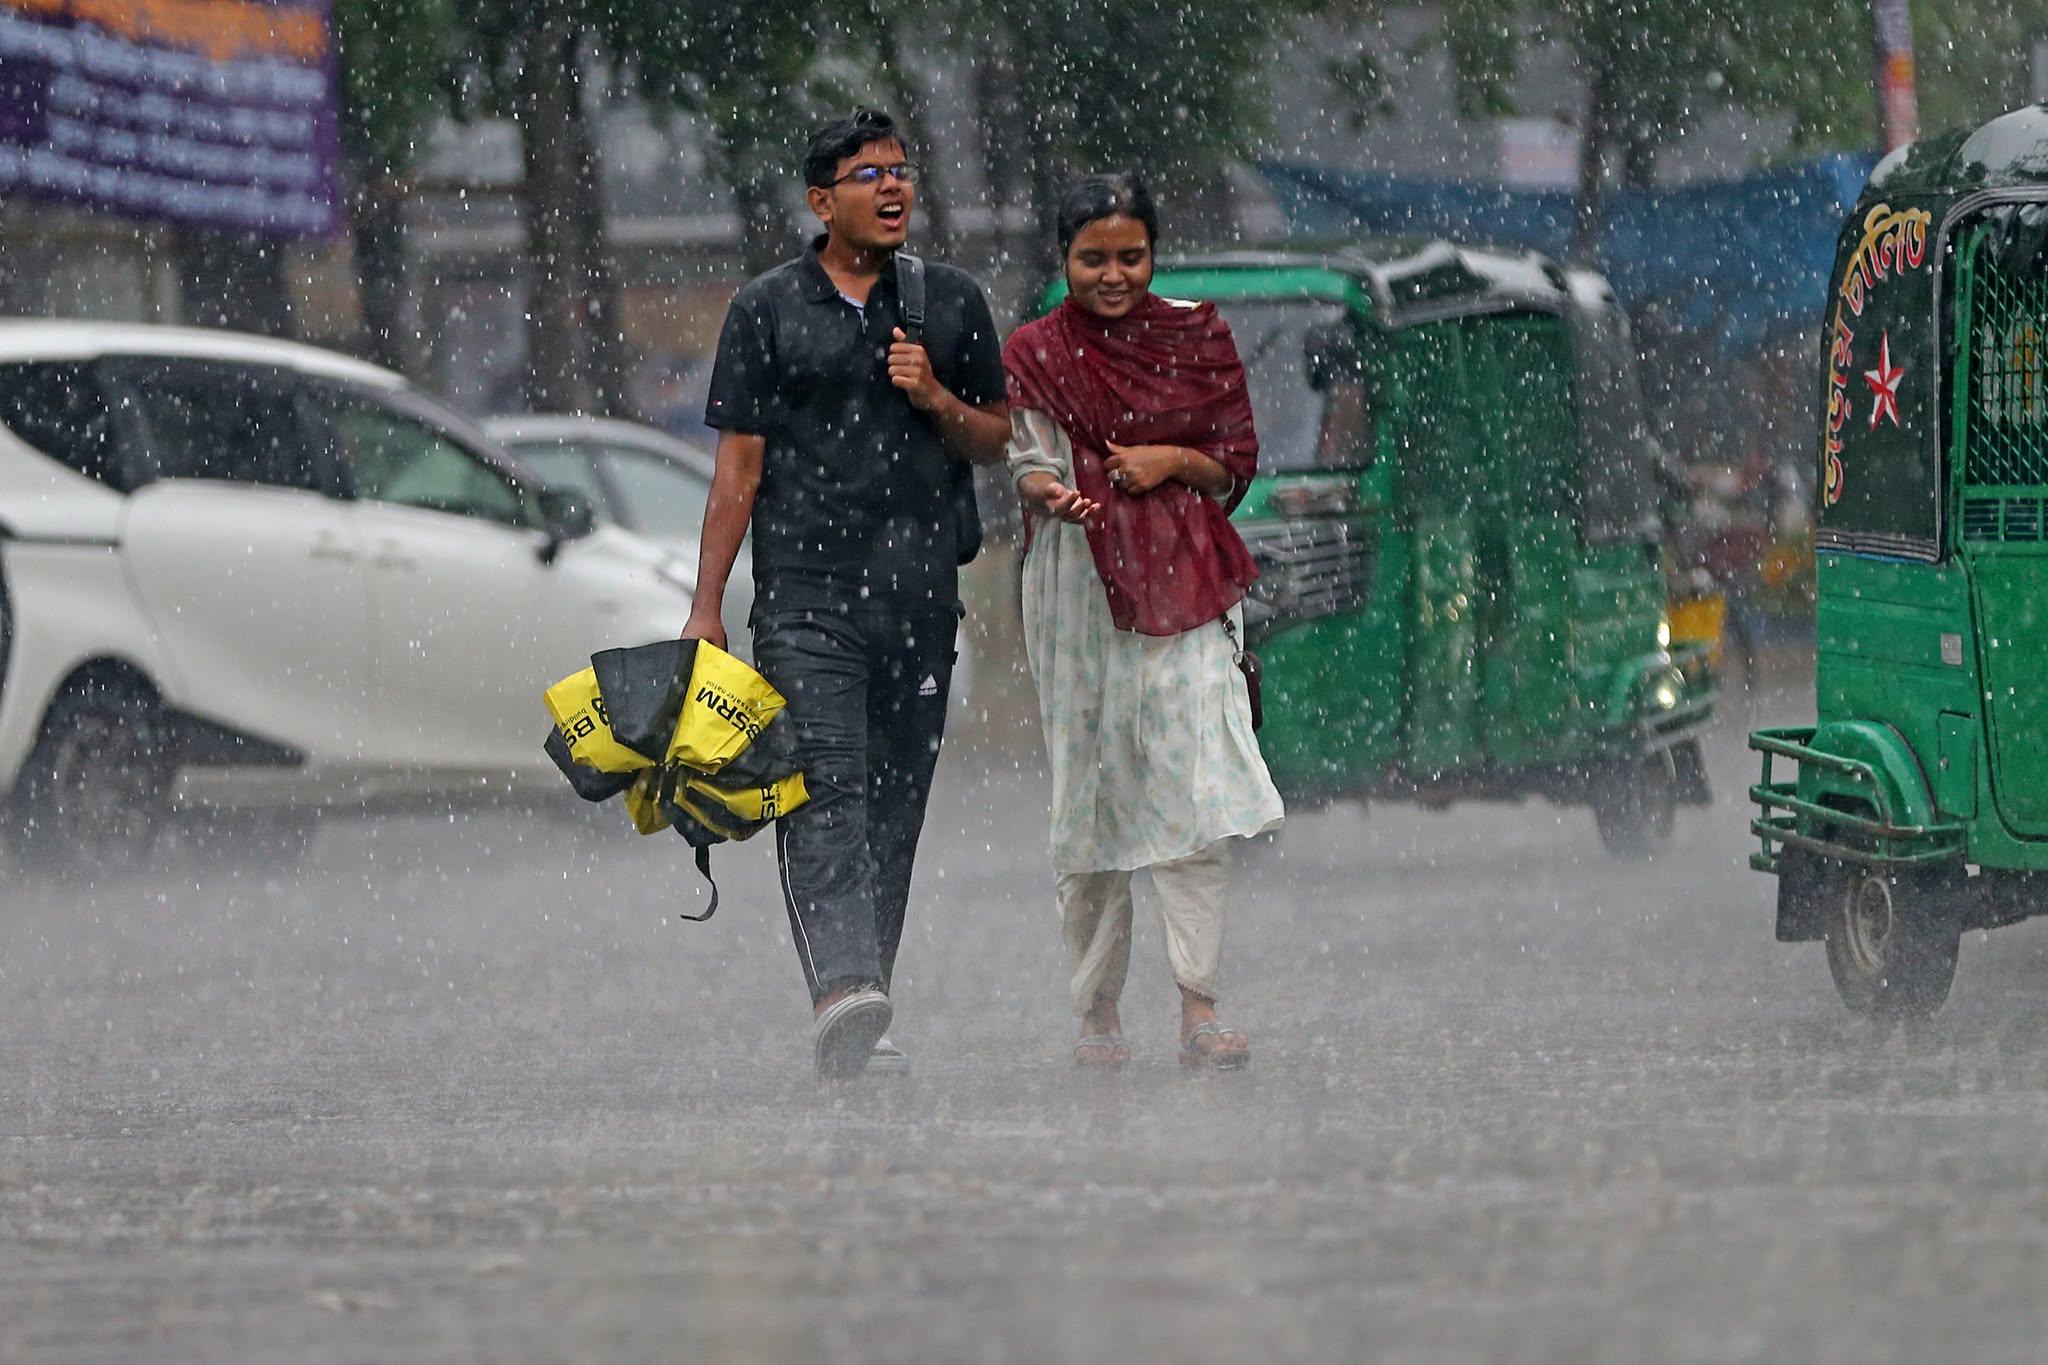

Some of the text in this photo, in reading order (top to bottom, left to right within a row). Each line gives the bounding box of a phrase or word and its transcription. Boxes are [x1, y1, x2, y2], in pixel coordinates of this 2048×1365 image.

[1825, 203, 1932, 508] ভাড়ায় চালিত
[695, 687, 761, 743] BSRM
